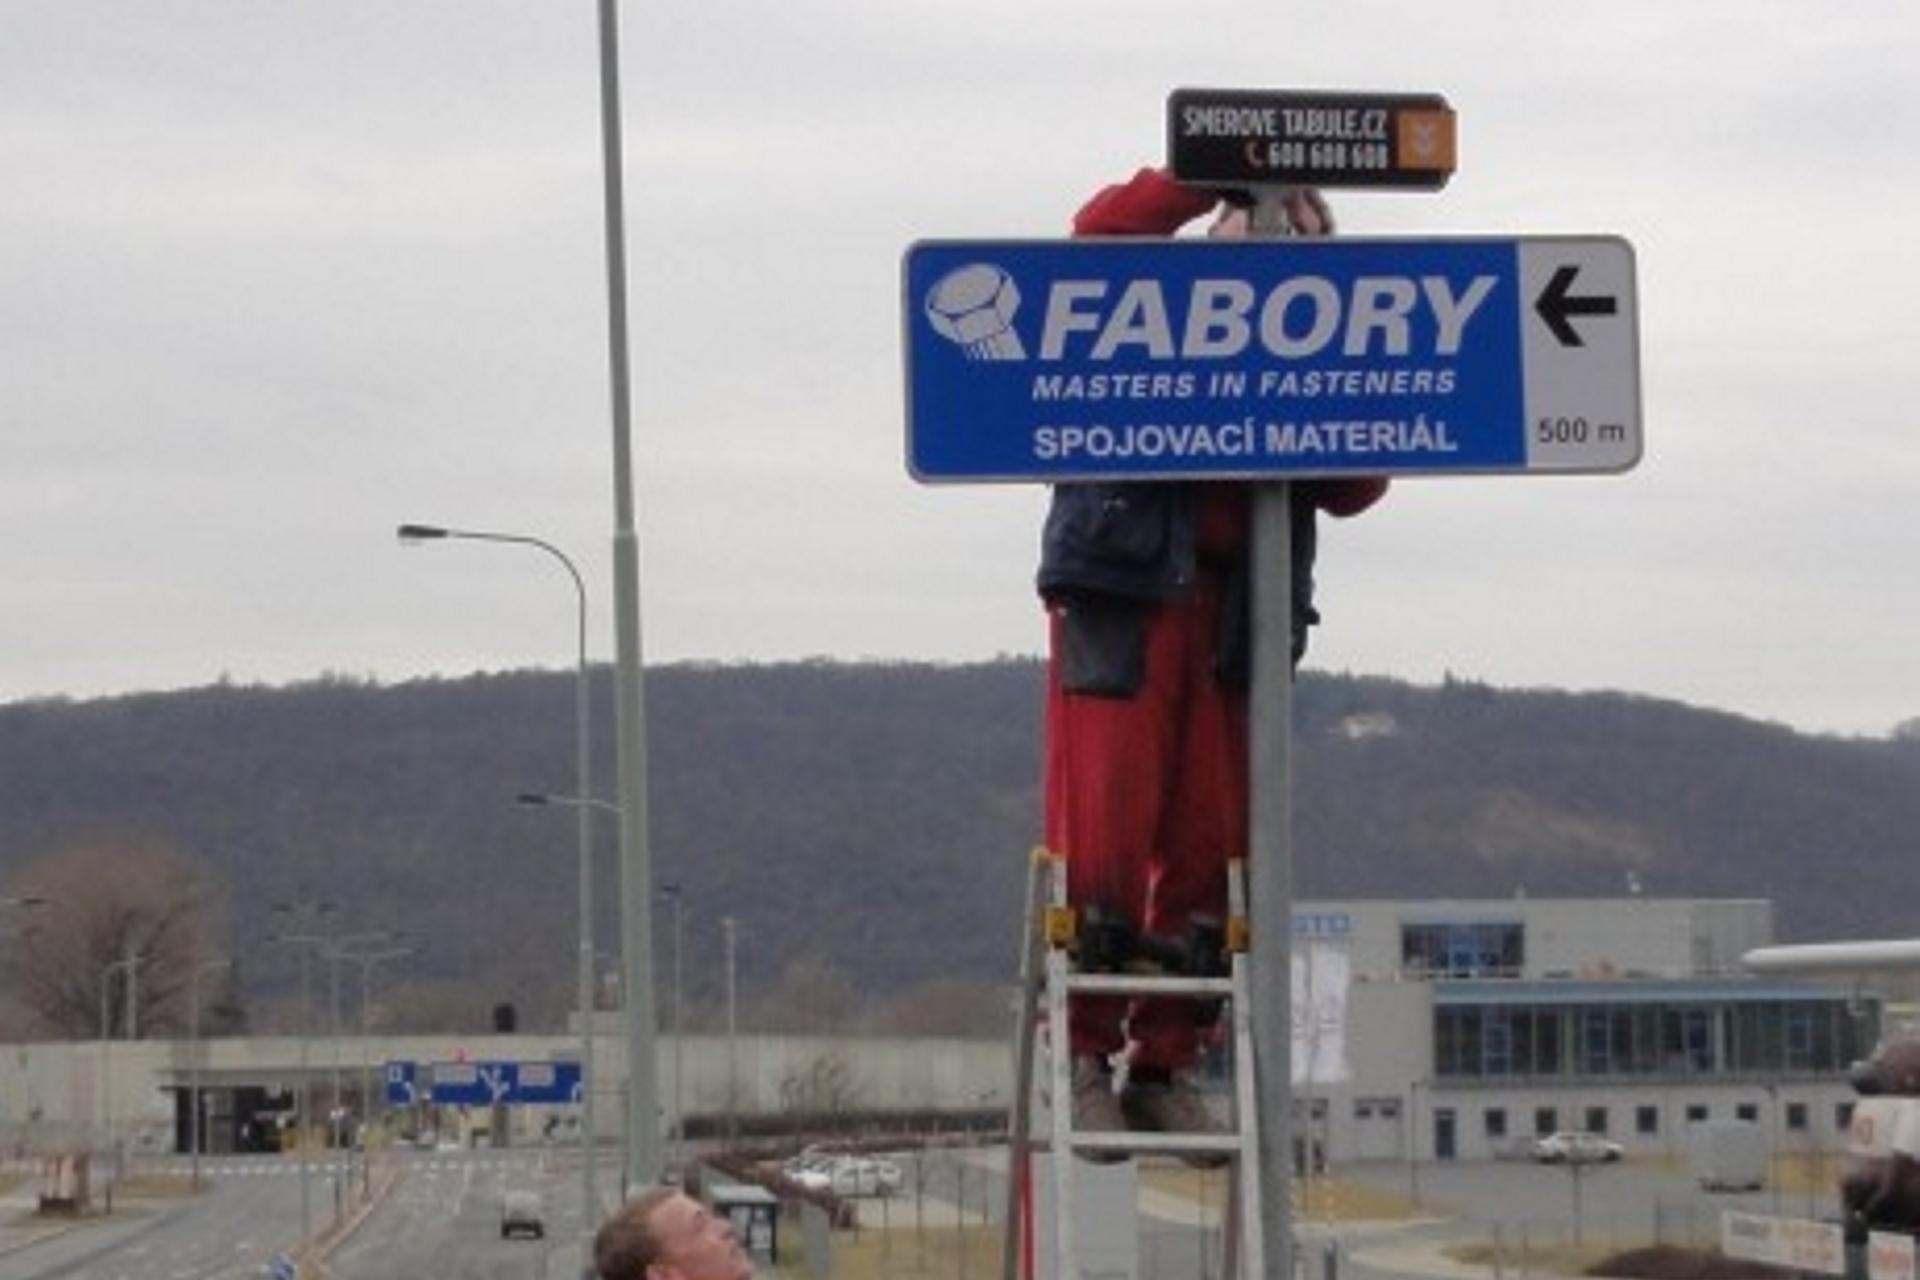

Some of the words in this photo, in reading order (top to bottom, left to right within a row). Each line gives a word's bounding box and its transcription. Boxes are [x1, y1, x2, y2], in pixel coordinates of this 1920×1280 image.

[1039, 274, 1499, 360] FABORY
[1032, 372, 1196, 400] MASTERS
[1210, 372, 1247, 397] IN
[1259, 370, 1457, 397] FASTENERS
[1034, 416, 1255, 460] SPOJOVACÍ
[1264, 412, 1458, 455] MATERIÁL
[1539, 416, 1588, 443] 500
[1598, 423, 1625, 442] m
